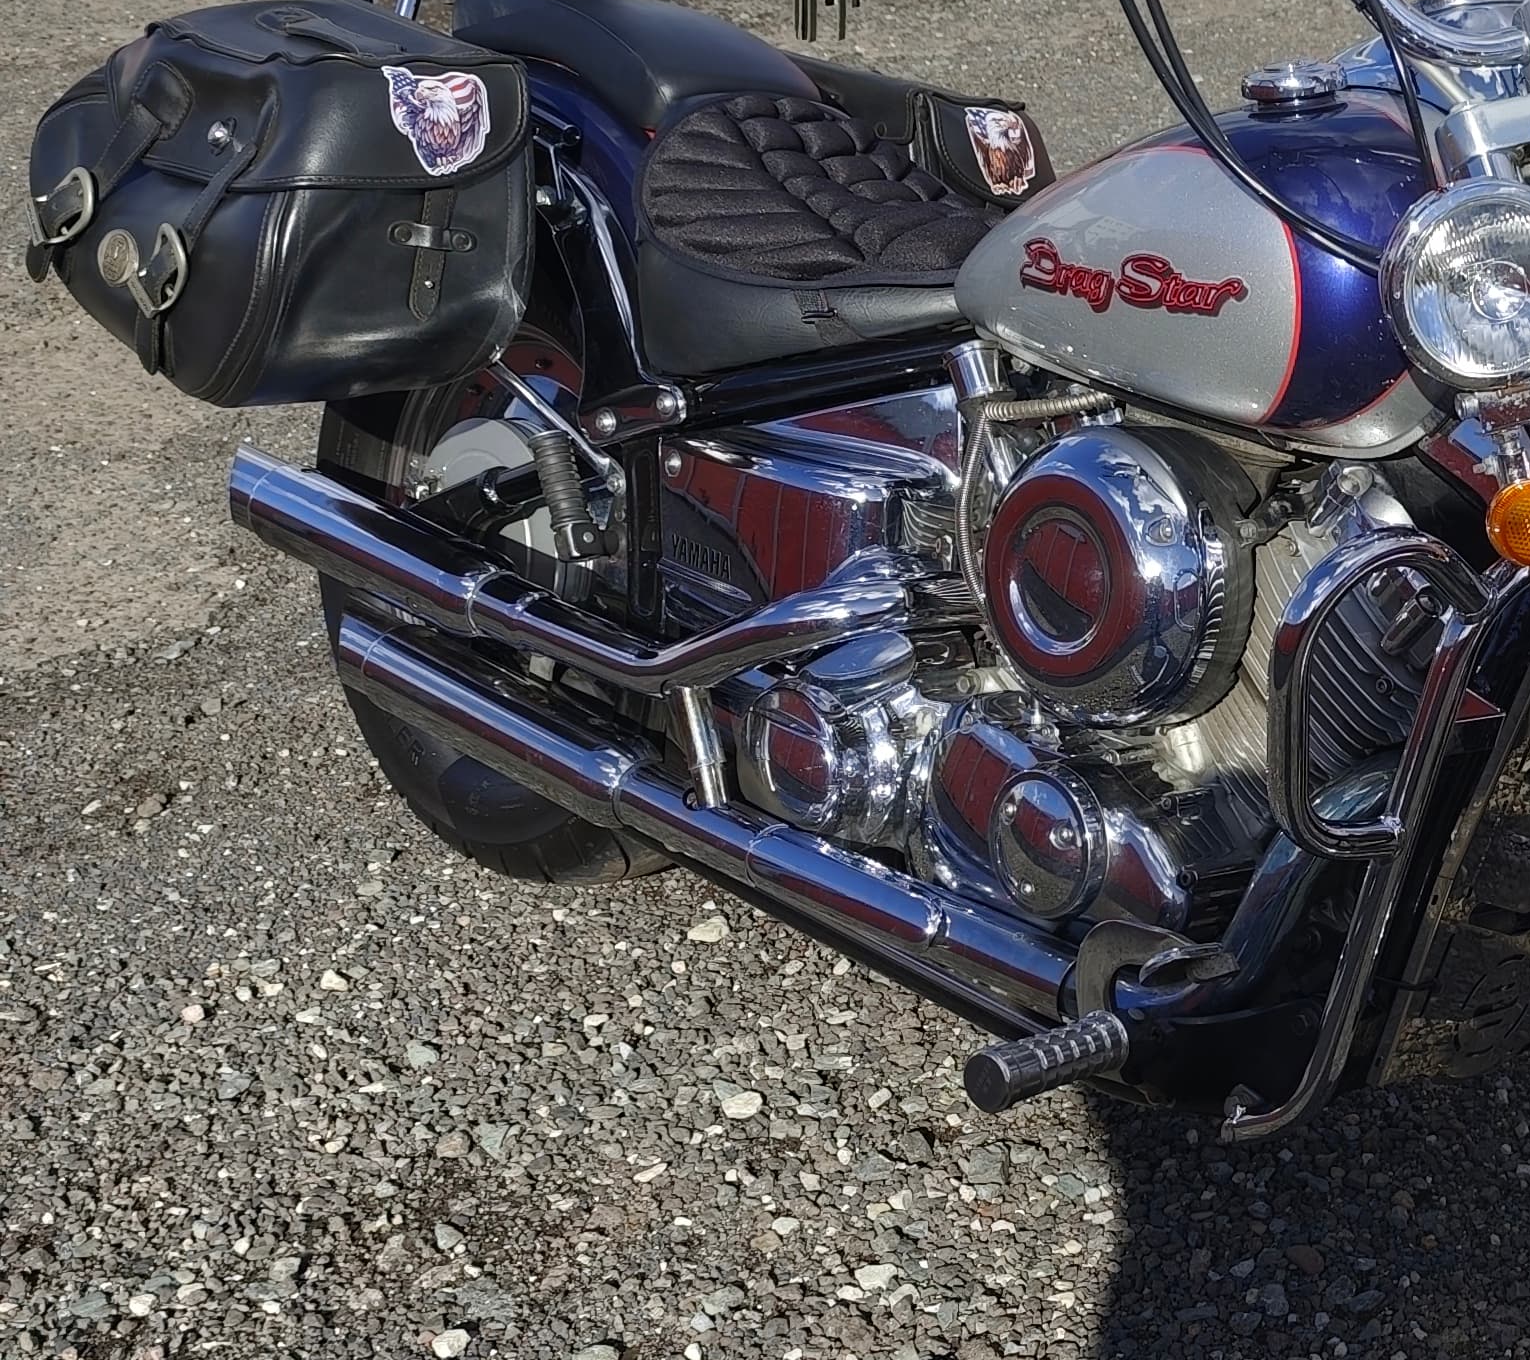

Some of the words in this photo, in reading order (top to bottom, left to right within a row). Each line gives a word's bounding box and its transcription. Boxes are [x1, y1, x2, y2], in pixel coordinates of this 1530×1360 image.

[1019, 237, 1115, 314] Drag
[1115, 253, 1249, 317] Star
[671, 532, 731, 582] YAMAHA
